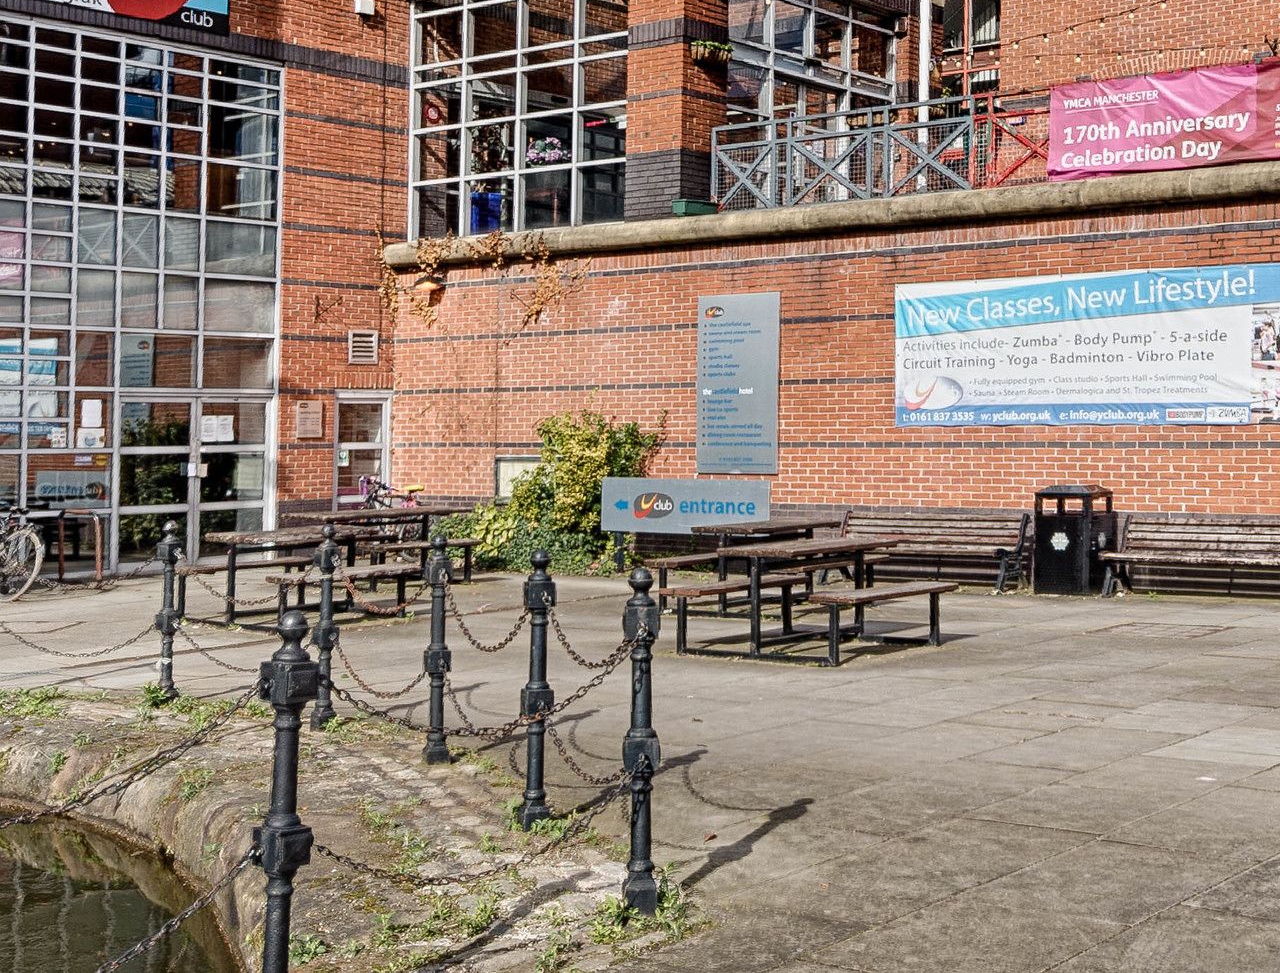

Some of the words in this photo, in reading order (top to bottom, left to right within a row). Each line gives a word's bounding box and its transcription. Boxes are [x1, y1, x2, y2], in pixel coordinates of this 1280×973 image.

[181, 10, 214, 28] club
[1062, 97, 1092, 110] YMCA
[1093, 89, 1160, 107] MANCHESTER
[1062, 121, 1121, 146] 170th
[1125, 112, 1251, 139] Anniversary
[1061, 143, 1176, 169] Celebration
[1181, 139, 1223, 161] Day
[908, 304, 961, 328] New
[966, 295, 1060, 321] Classes,
[1067, 287, 1126, 311] New
[1133, 269, 1256, 305] Lifestyle!
[903, 340, 956, 352] Activities
[1074, 332, 1108, 348] Body
[1169, 329, 1228, 343] 5-a-side
[902, 357, 942, 370] Circuit
[944, 355, 996, 370] Training
[1006, 354, 1038, 369] Yoga
[1050, 351, 1124, 365] Badminton
[1136, 349, 1174, 363] Vibro
[1178, 348, 1215, 362] Plate
[1104, 374, 1131, 384] Sports
[1154, 373, 1197, 384] Swimming
[1105, 386, 1120, 394] and
[1162, 385, 1208, 394] Treatments
[951, 411, 975, 421] 3535
[654, 499, 673, 511] club
[679, 498, 756, 515] entrance
